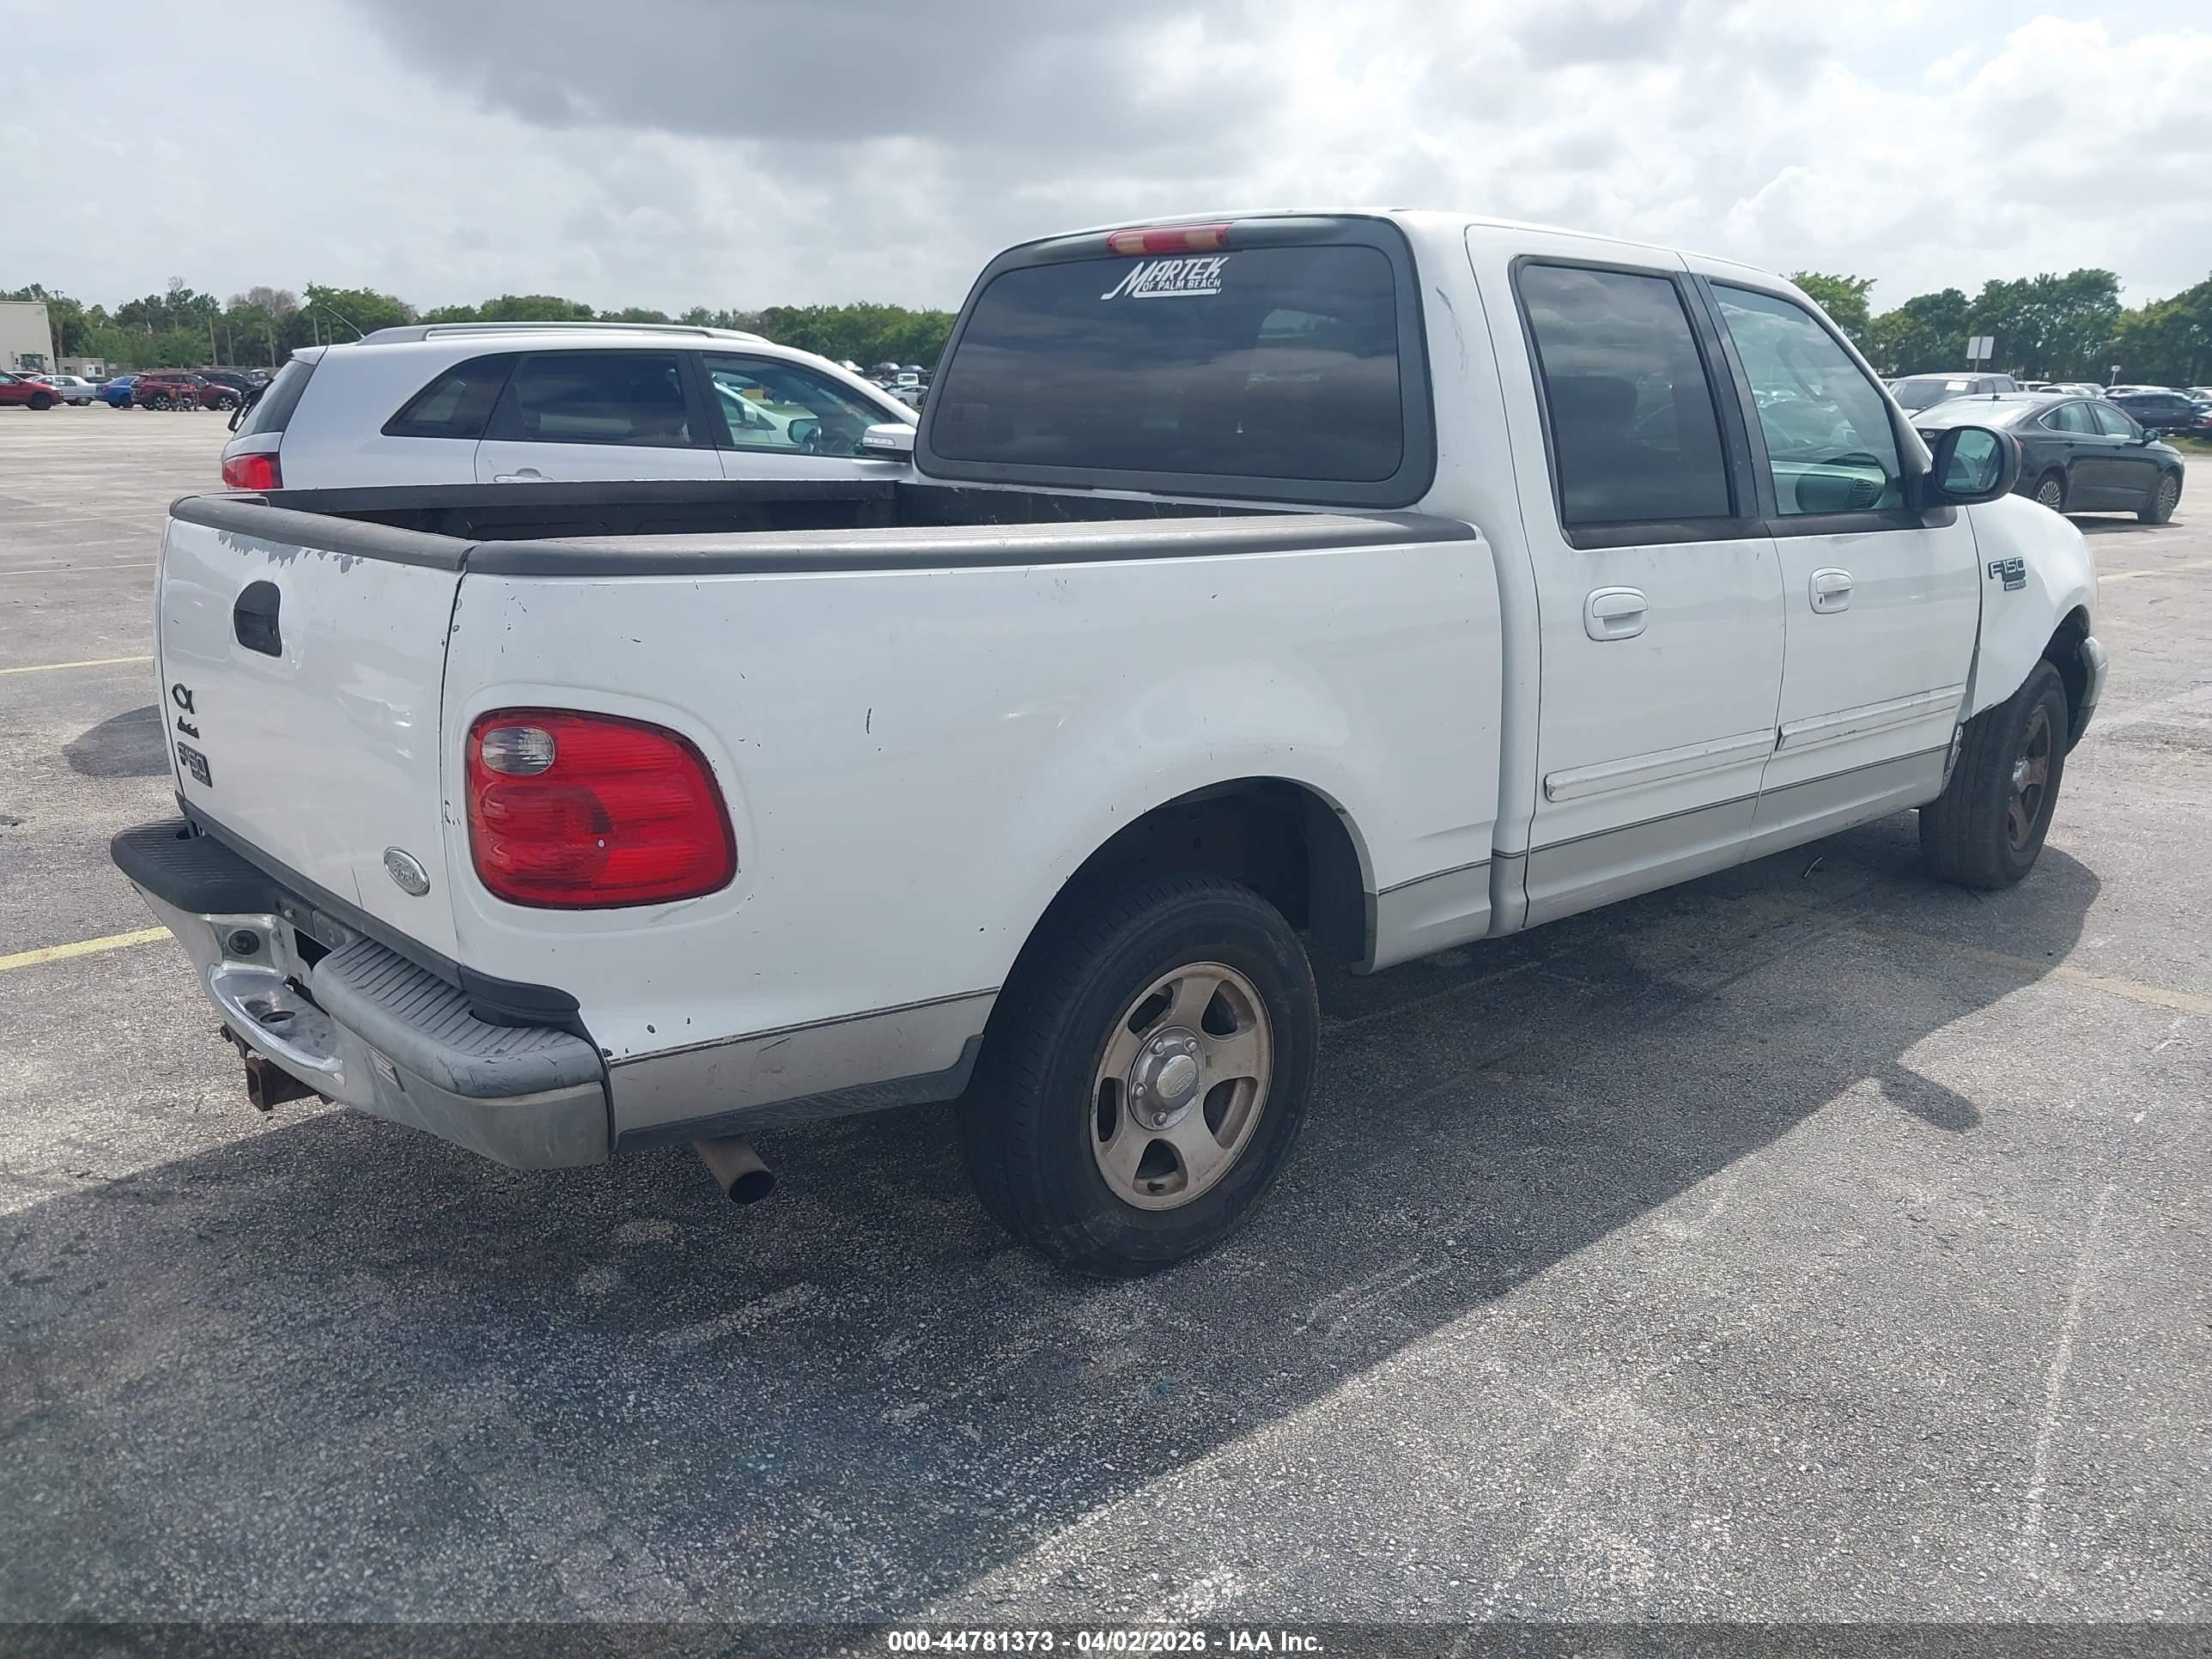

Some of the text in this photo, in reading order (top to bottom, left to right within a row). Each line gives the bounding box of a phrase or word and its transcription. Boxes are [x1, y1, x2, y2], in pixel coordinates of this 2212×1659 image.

[1101, 257, 1230, 300] MARTEK
[1142, 278, 1222, 292] OF PALM BEACH
